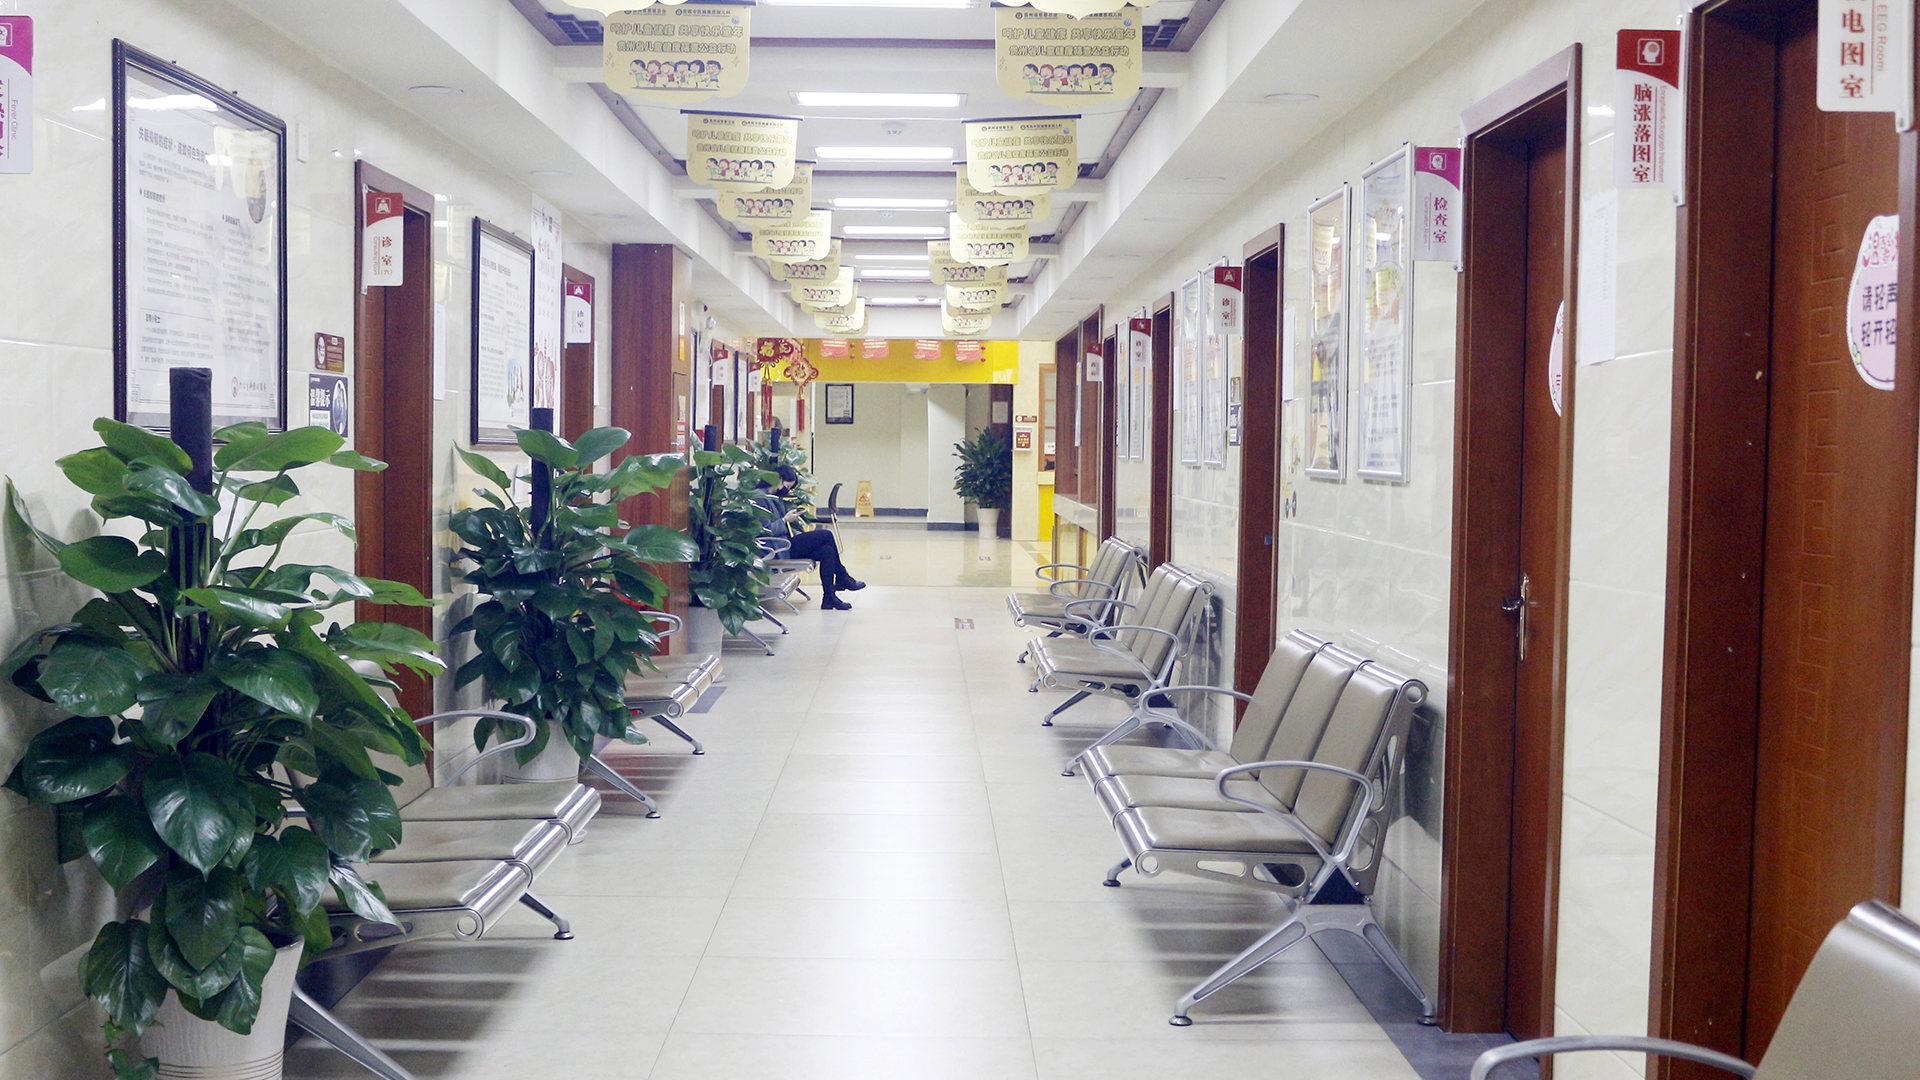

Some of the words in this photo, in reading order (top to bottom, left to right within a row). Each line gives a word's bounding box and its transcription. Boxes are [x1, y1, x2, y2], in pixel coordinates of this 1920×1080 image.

[1877, 4, 1888, 31] EEG
[1839, 0, 1866, 99] 电图室
[1876, 36, 1887, 72] Room
[11, 121, 19, 140] Clinic
[1632, 84, 1653, 183] 脑涨落图室
[1432, 197, 1448, 243] 检查室
[759, 341, 775, 357] 福
